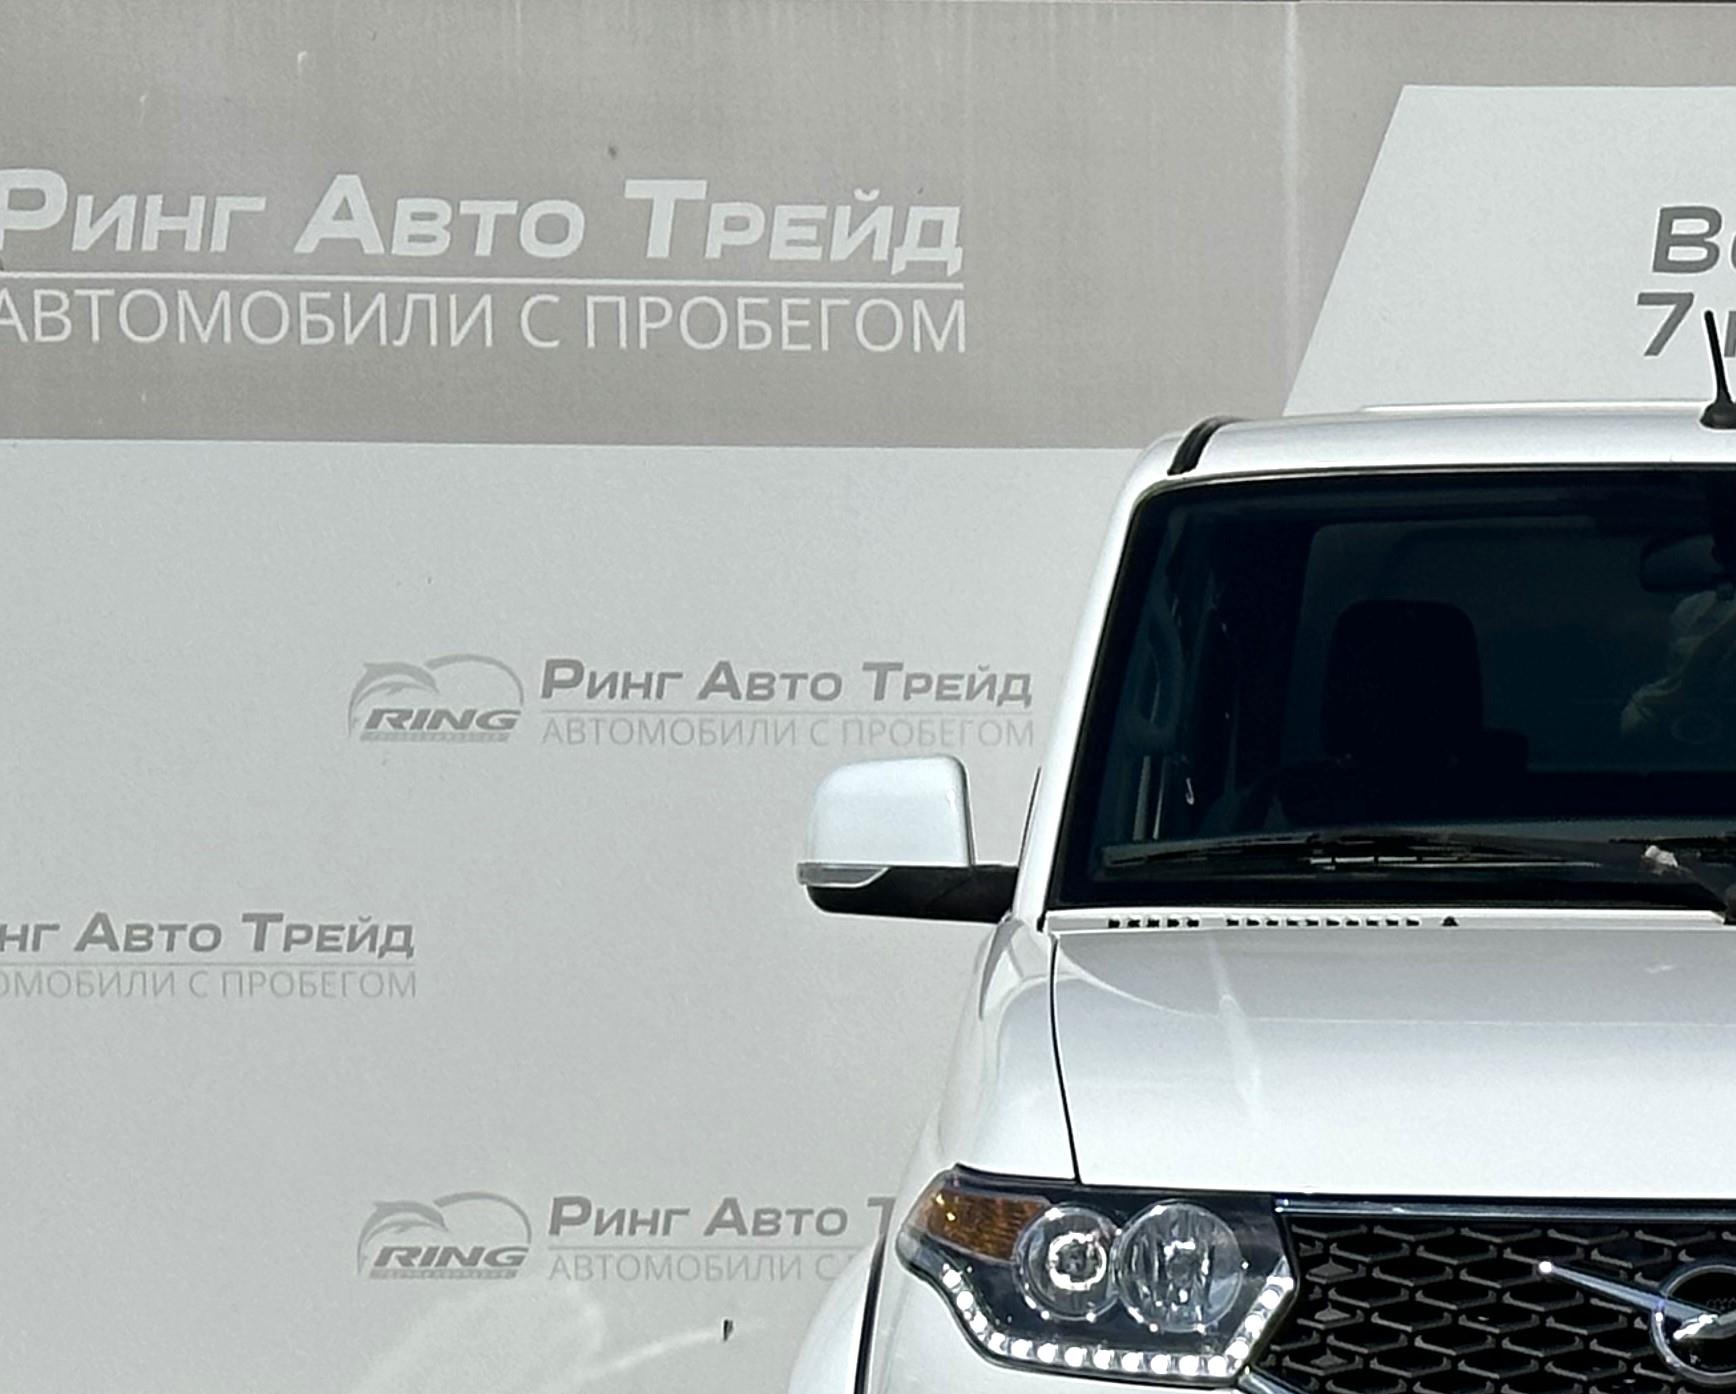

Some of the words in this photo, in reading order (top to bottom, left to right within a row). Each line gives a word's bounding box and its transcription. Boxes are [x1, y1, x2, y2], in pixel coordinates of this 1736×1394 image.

[292, 171, 586, 258] Авто
[622, 177, 964, 276] Трейд
[0, 286, 492, 346] АВТОМОБИЛИ
[519, 291, 560, 348] С
[585, 294, 967, 352] ПРОБЕГОМ
[1636, 291, 1694, 358] 7
[696, 659, 844, 702] Авто
[860, 663, 1033, 708] Трейд
[366, 707, 522, 730] RING
[543, 716, 796, 747] АВТОМОБИЛИ
[809, 718, 834, 747] С
[844, 719, 1034, 748] ПРОБЕГОМ
[74, 911, 223, 952] Авто
[242, 911, 414, 959] Трейд
[189, 970, 208, 998] С
[222, 970, 416, 999] ПРОБЕГОМ
[704, 1197, 848, 1236] Авто
[375, 1245, 528, 1267] RING
[549, 1253, 800, 1281] АВТОМОБИЛИ
